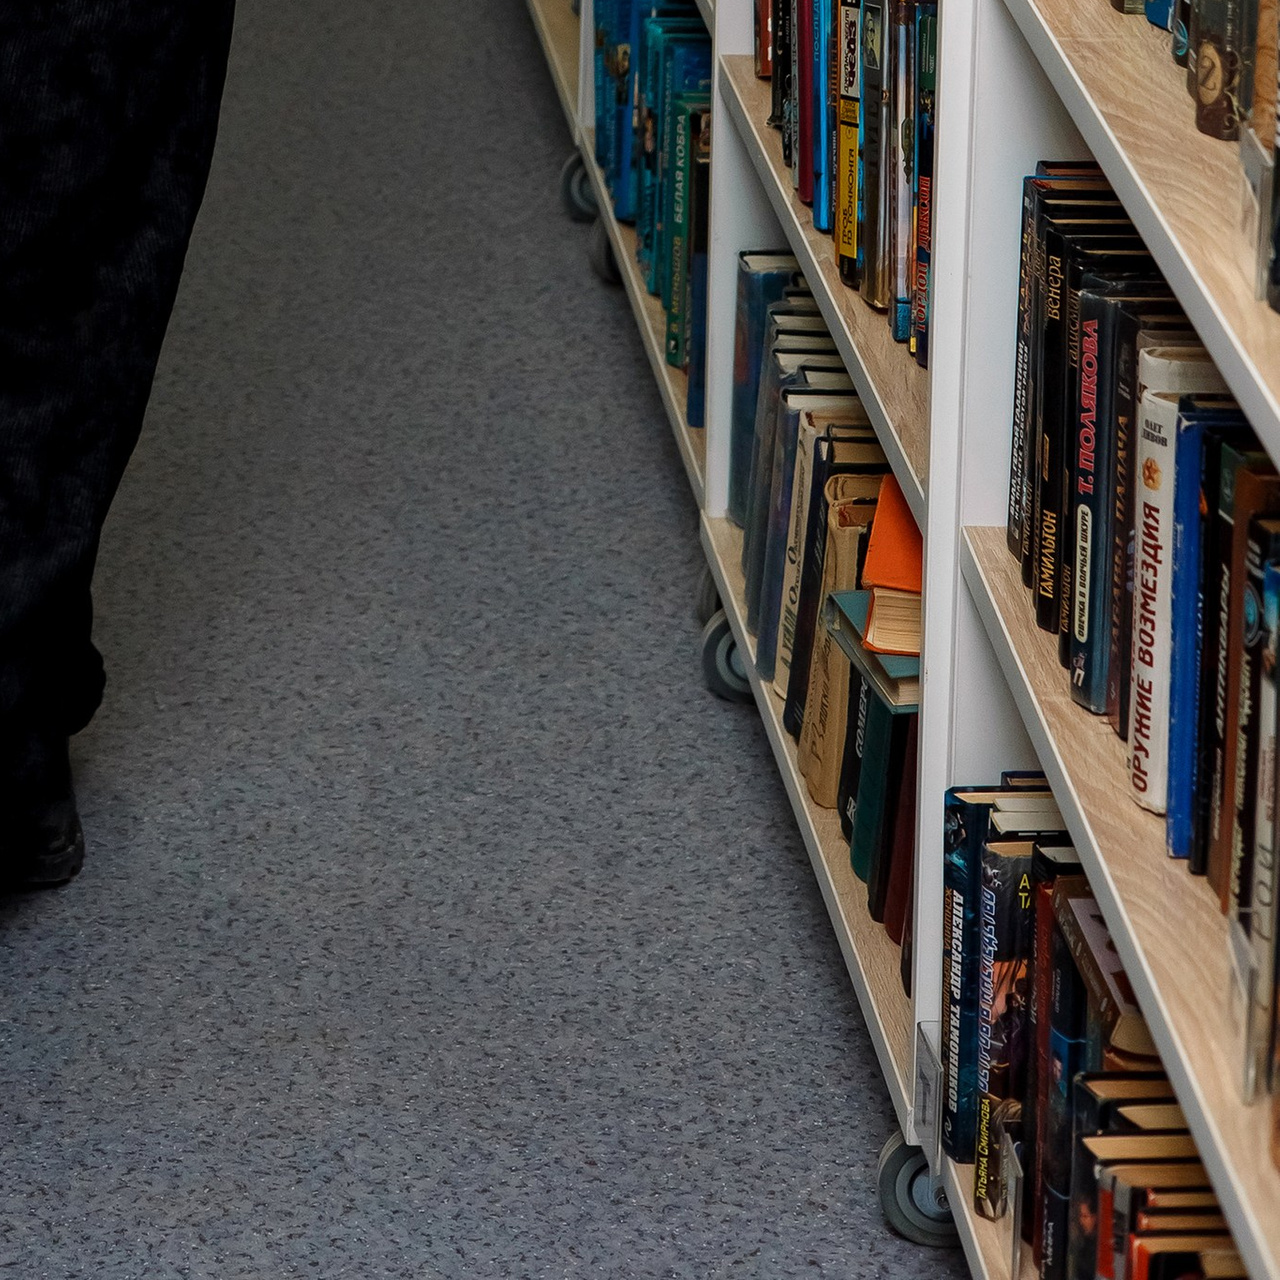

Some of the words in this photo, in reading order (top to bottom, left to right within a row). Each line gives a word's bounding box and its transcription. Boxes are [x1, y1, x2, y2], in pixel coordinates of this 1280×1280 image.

[676, 114, 686, 168] КОБРА
[674, 171, 684, 224] БЕЛАЯ
[847, 148, 855, 227] ГОНКОНГА
[916, 261, 928, 333] ГОРДОН
[1046, 255, 1064, 321] Венера
[1079, 318, 1098, 473] ПОЛЯКОВА
[1012, 427, 1021, 471] ГЕРОЙ
[1115, 415, 1128, 522] ПАЛАЧА
[1078, 476, 1094, 495] Т.
[1039, 510, 1056, 599] ГАМИЛЬТОН
[1080, 510, 1089, 543] ШКУРЕ
[1078, 545, 1088, 589] ВОЛЧЬЕЙ
[1137, 501, 1163, 669] ВОЗМЕЗДИЯ
[1077, 601, 1086, 638] ОВЕЧКА
[1215, 562, 1230, 740] АНТИКВАРЫ
[1131, 674, 1153, 794] ОРУЖИЕ
[950, 889, 963, 999] АЛЕКСАНДР
[948, 1004, 960, 1113] ТАМОНИКОВ
[978, 1098, 990, 1155] СМИРНОВА
[976, 1157, 989, 1200] ТАТЬЯНА
